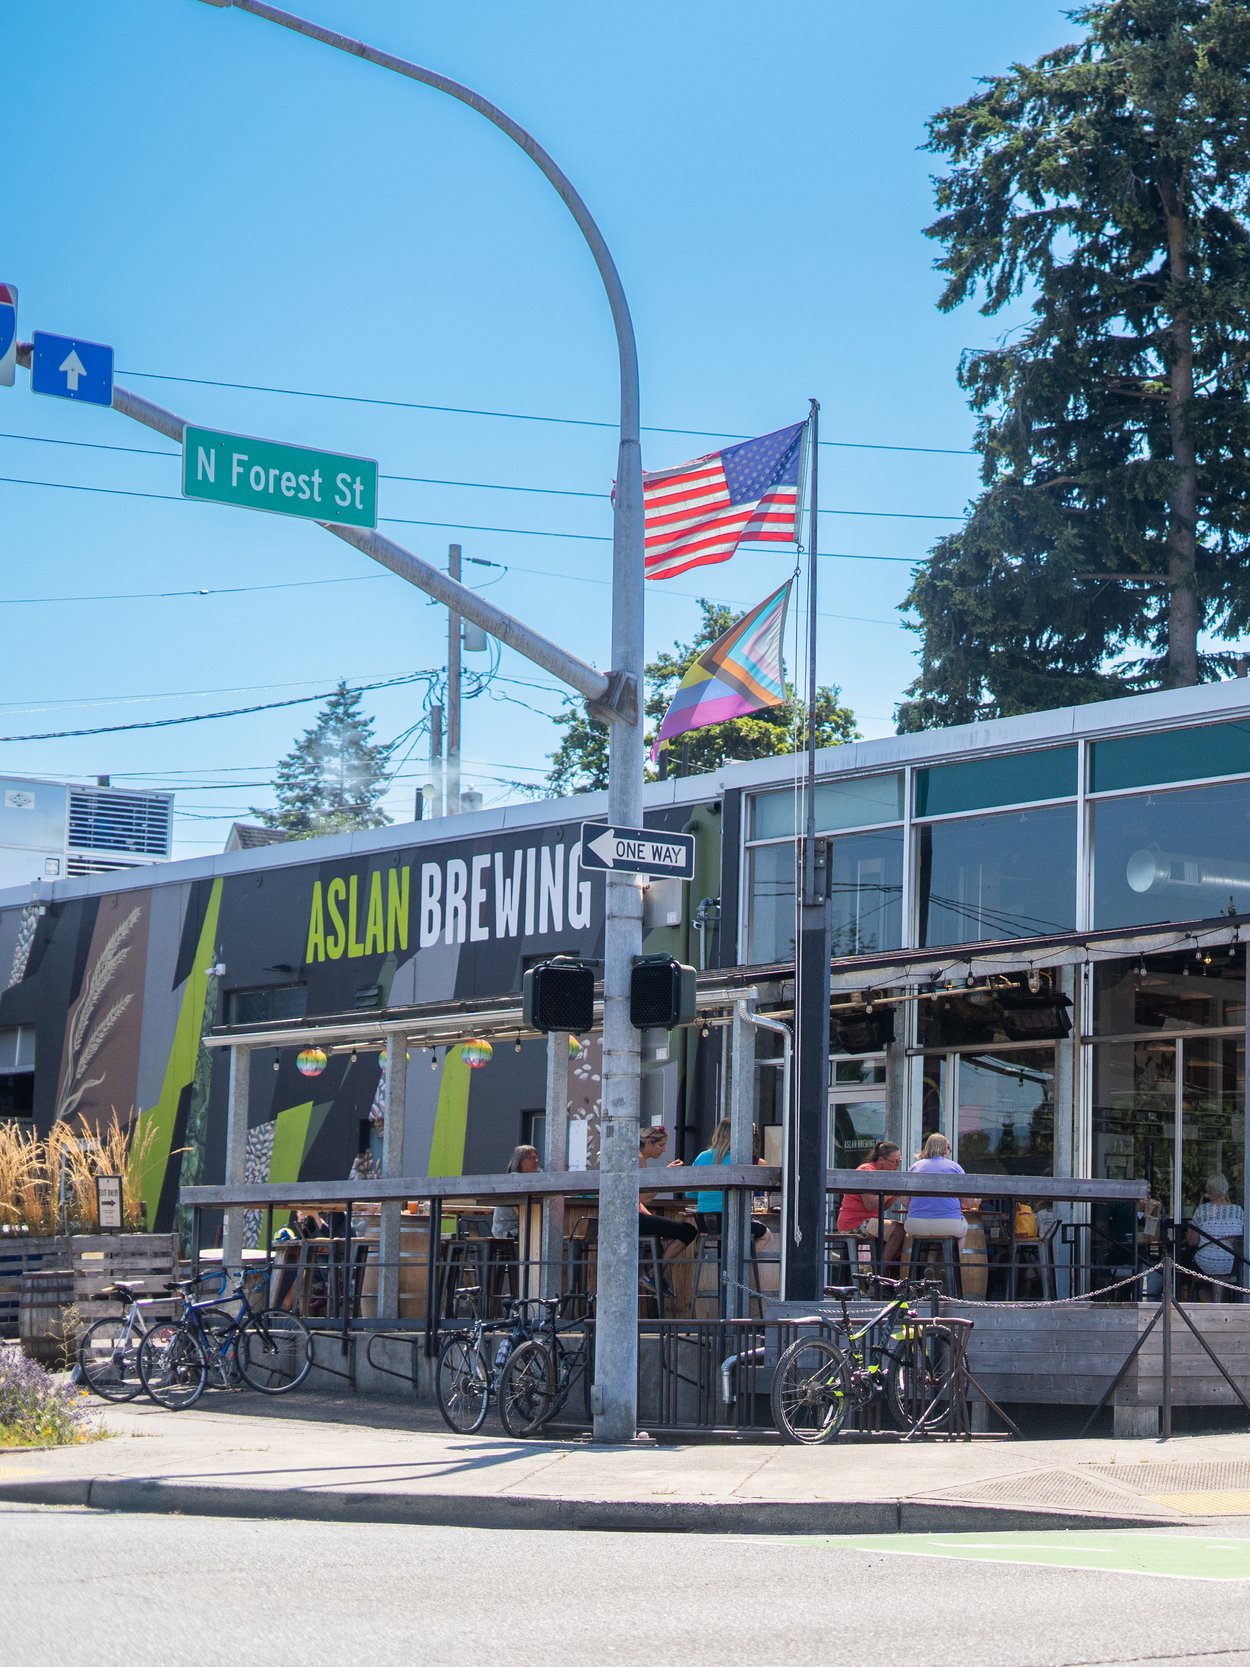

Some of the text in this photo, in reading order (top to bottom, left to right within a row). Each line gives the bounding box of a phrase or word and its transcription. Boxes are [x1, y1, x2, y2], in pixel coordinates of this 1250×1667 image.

[197, 446, 365, 510] N Forest St
[615, 840, 682, 864] ONE WAY
[305, 841, 592, 964] ASLAN BREWING
